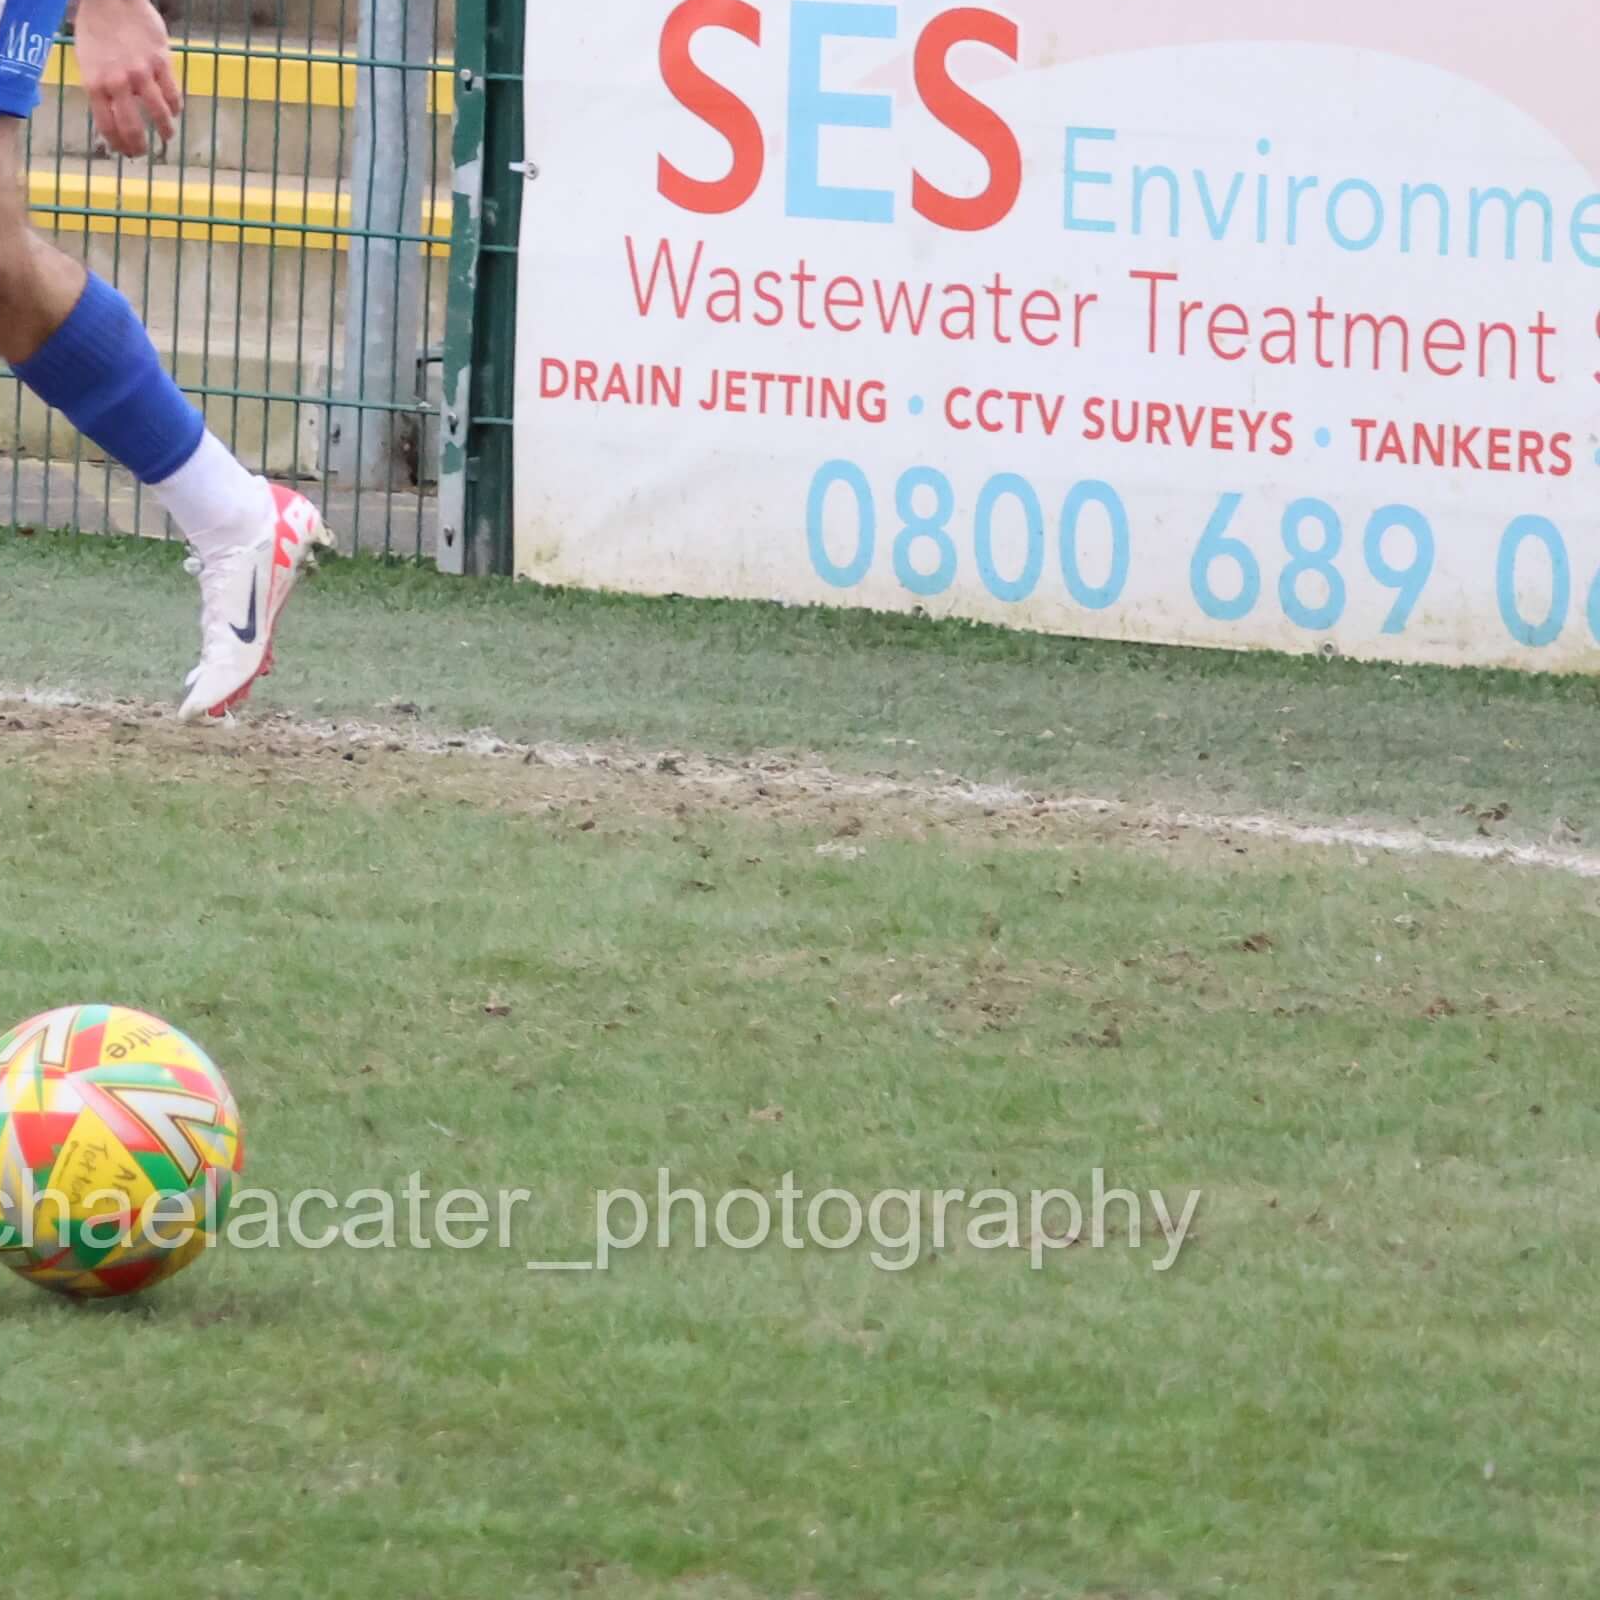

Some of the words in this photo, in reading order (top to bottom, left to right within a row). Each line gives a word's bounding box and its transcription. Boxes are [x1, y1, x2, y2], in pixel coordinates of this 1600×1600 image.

[625, 236, 1098, 348] Wastewater
[1130, 271, 1557, 384] Treatment
[539, 357, 683, 408] DRAIN
[699, 370, 888, 424] JETTING
[944, 387, 1065, 437] CCTV
[1082, 396, 1295, 456] SURVEYS
[1351, 418, 1573, 477] TANKERS
[807, 458, 1131, 609] 0800
[1190, 490, 1436, 634] 689
[1496, 514, 1600, 645] 0
